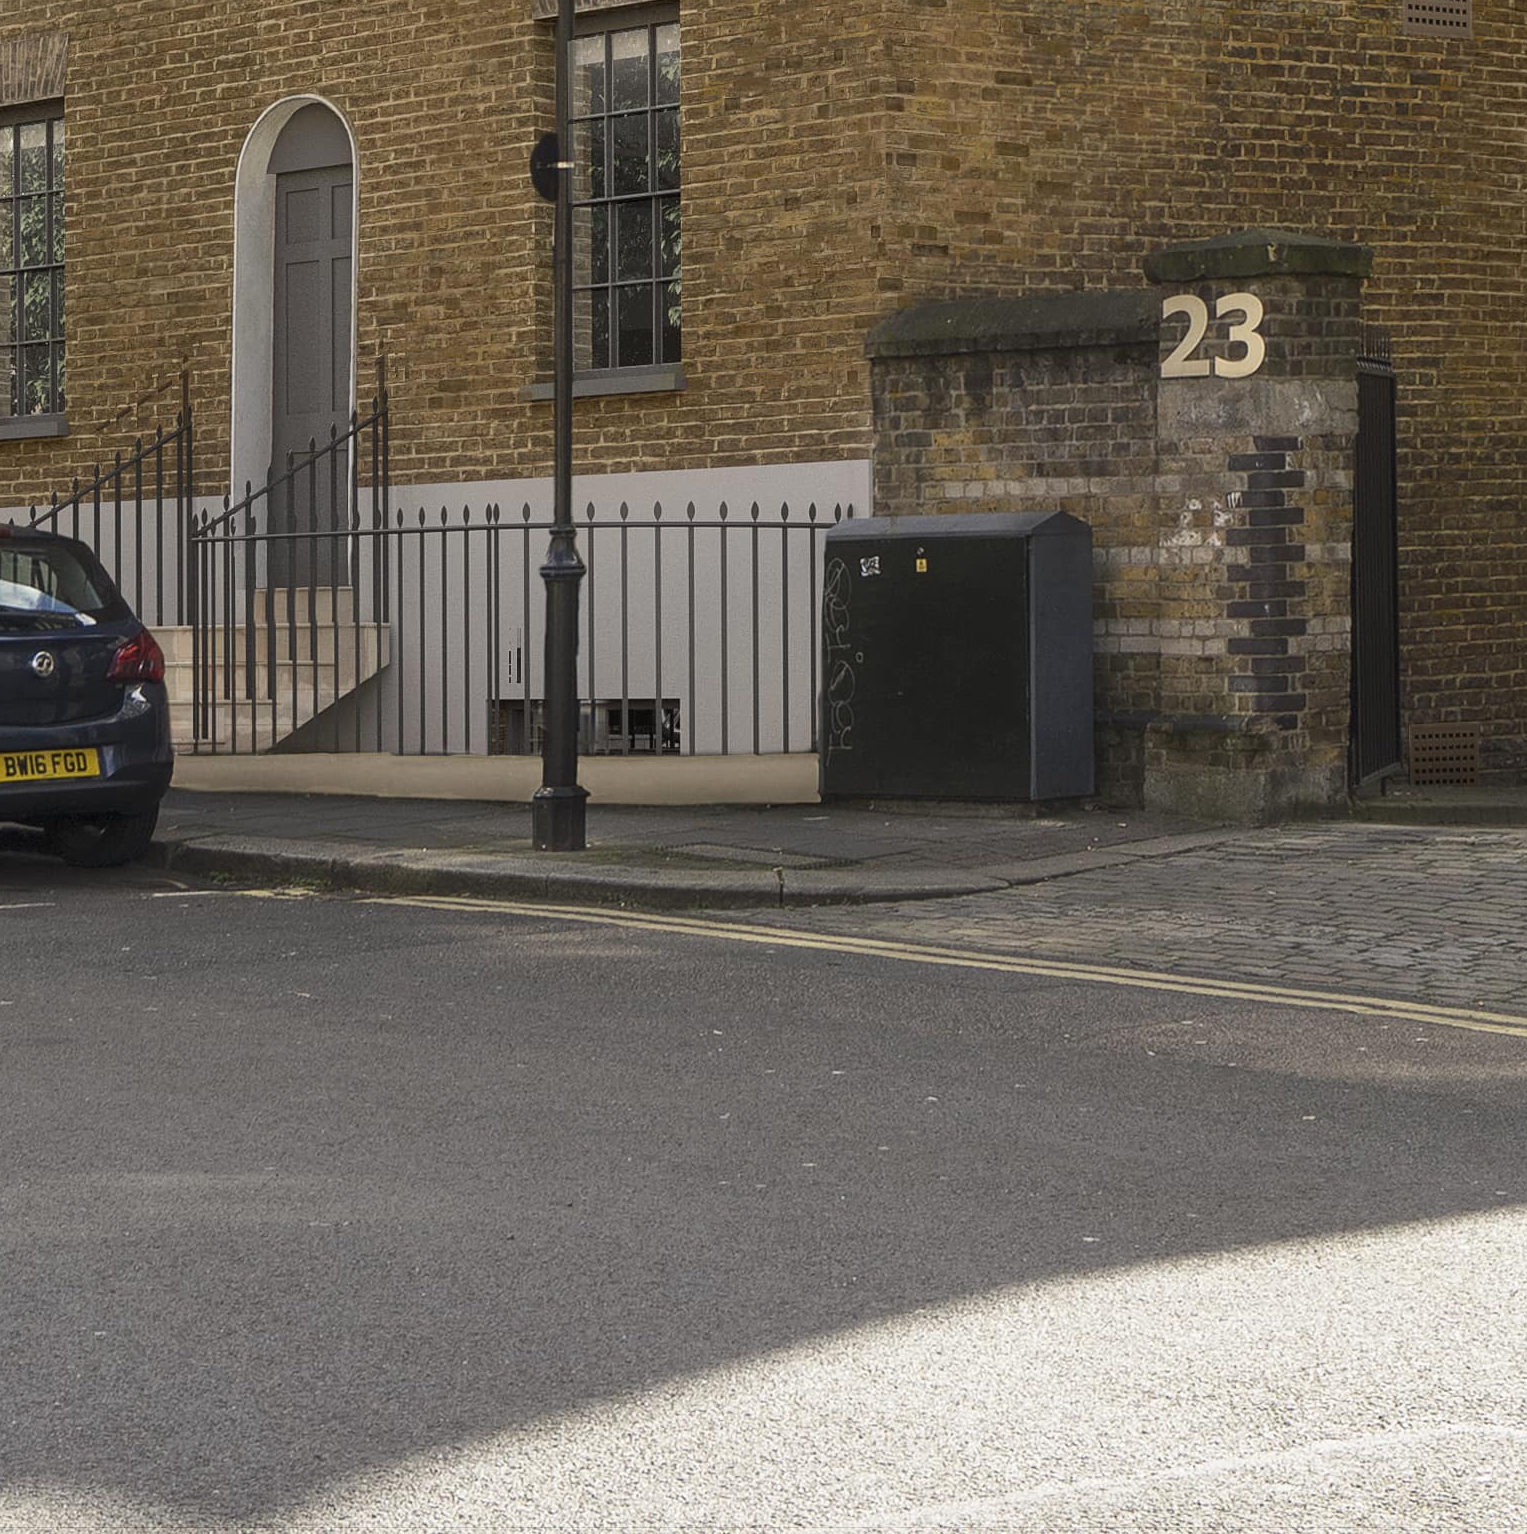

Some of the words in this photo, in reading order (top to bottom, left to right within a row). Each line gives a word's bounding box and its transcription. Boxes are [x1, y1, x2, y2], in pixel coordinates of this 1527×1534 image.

[1161, 292, 1266, 379] 23
[3, 754, 47, 777] BW16
[51, 751, 88, 774] FGD
